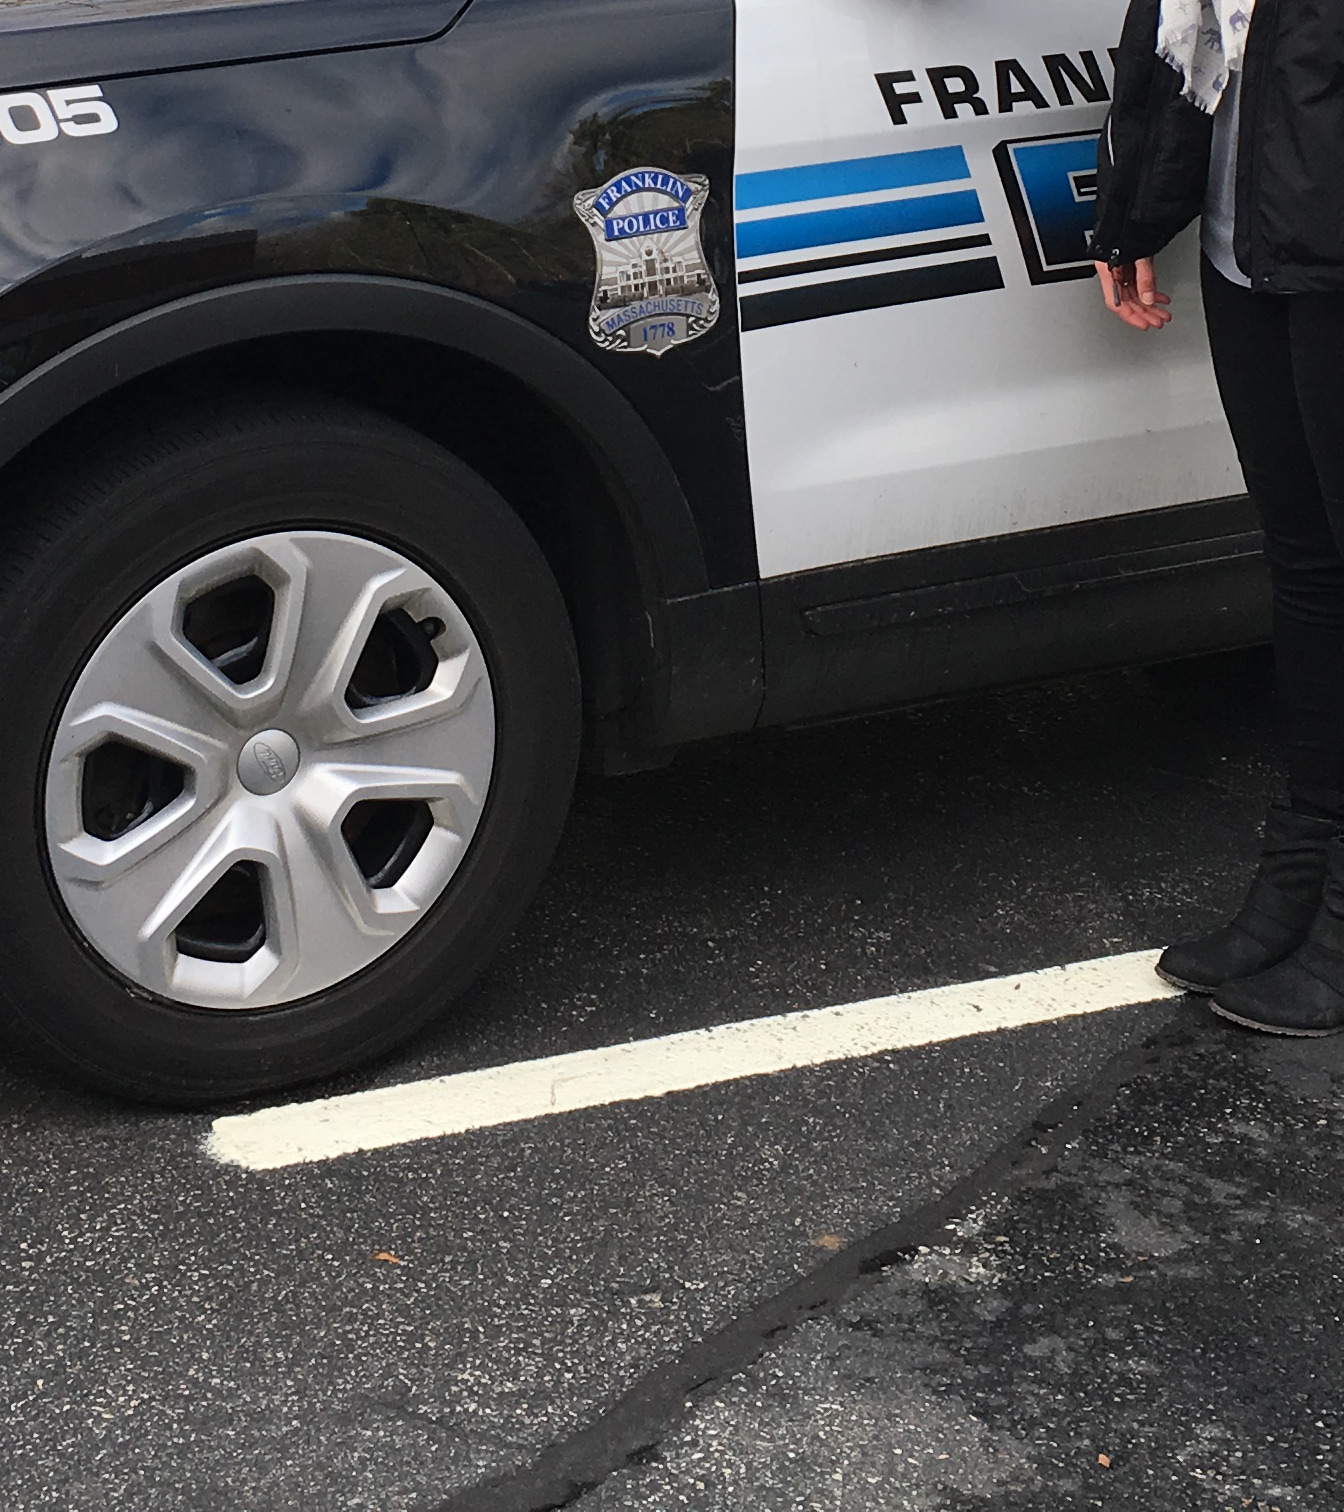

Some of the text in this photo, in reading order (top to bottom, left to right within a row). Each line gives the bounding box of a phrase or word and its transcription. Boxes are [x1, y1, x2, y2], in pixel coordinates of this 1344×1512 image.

[874, 46, 1119, 126] FRAN
[599, 172, 687, 215] FRANKLIN
[612, 210, 681, 236] POLICE
[606, 298, 704, 332] MASSACHUSETTS
[642, 321, 676, 342] 1778
